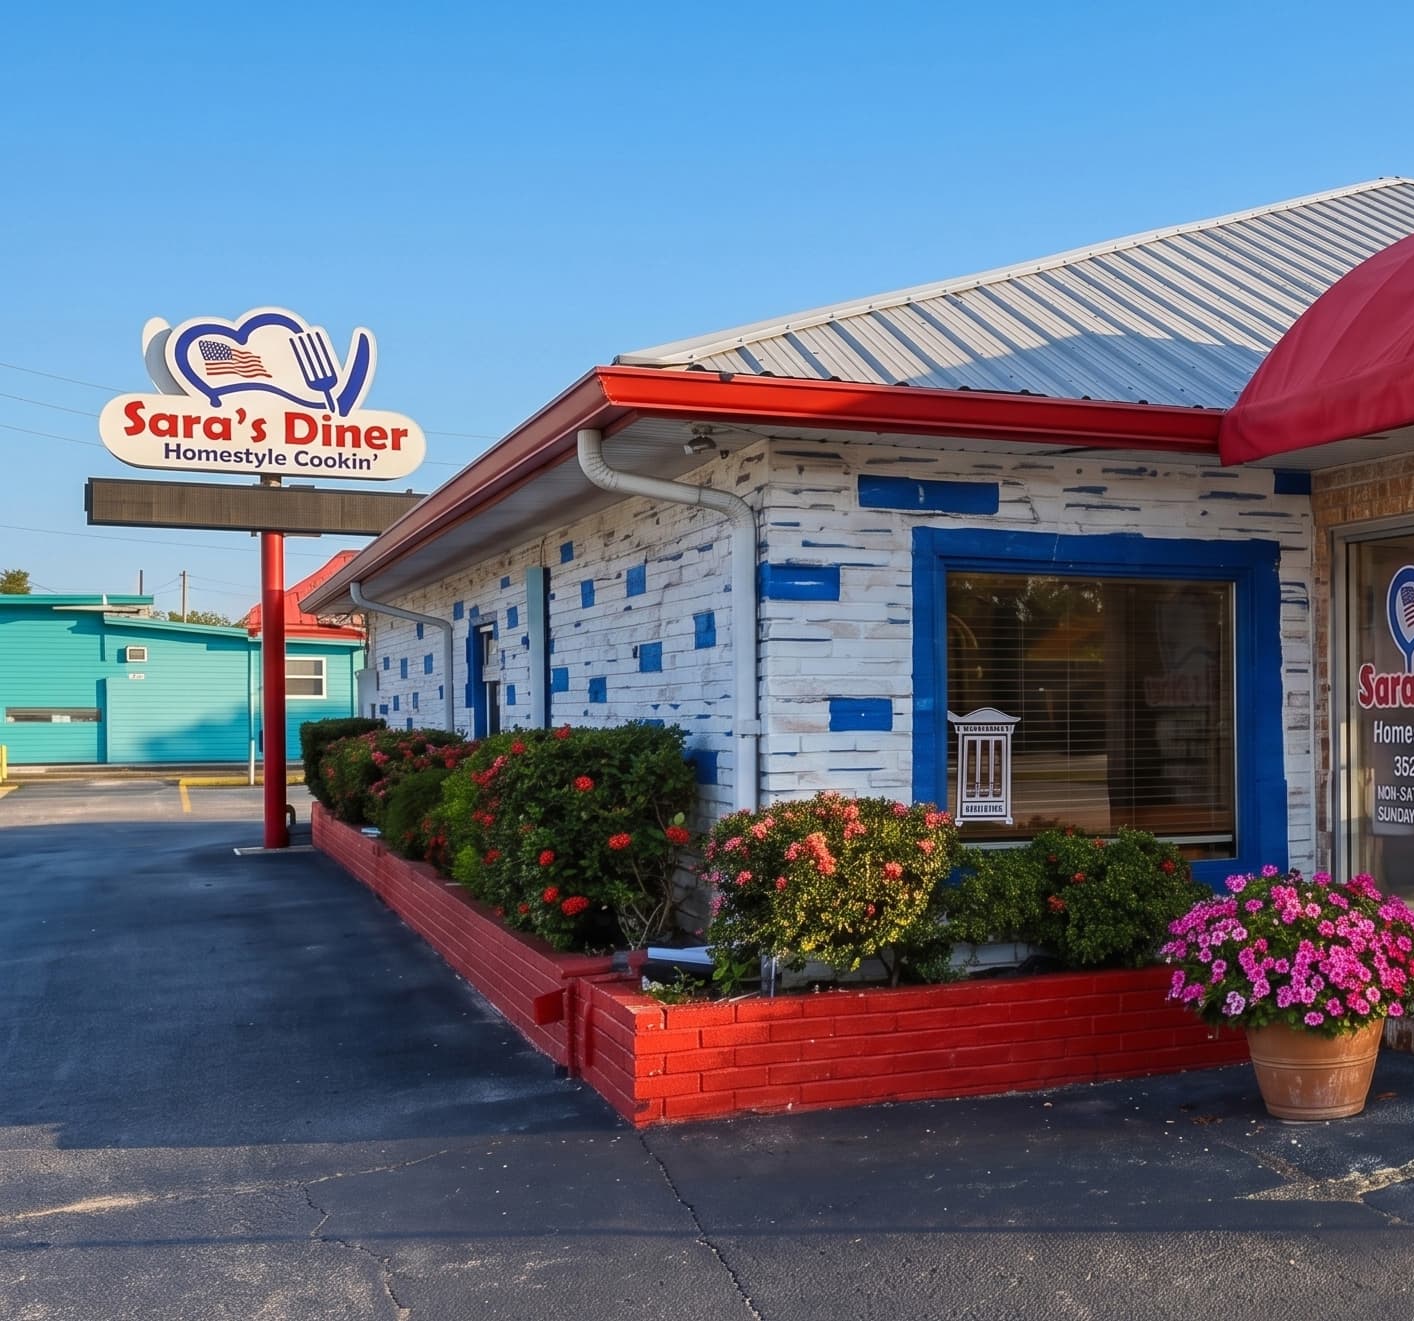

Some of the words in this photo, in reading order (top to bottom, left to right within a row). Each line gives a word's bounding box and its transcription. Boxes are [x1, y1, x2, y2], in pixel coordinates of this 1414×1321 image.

[124, 400, 267, 443] Sara's
[284, 411, 408, 451] Diner
[164, 443, 287, 468] Homestyle
[294, 449, 378, 470] Cookin'
[1378, 806, 1414, 824] SUNDAY
